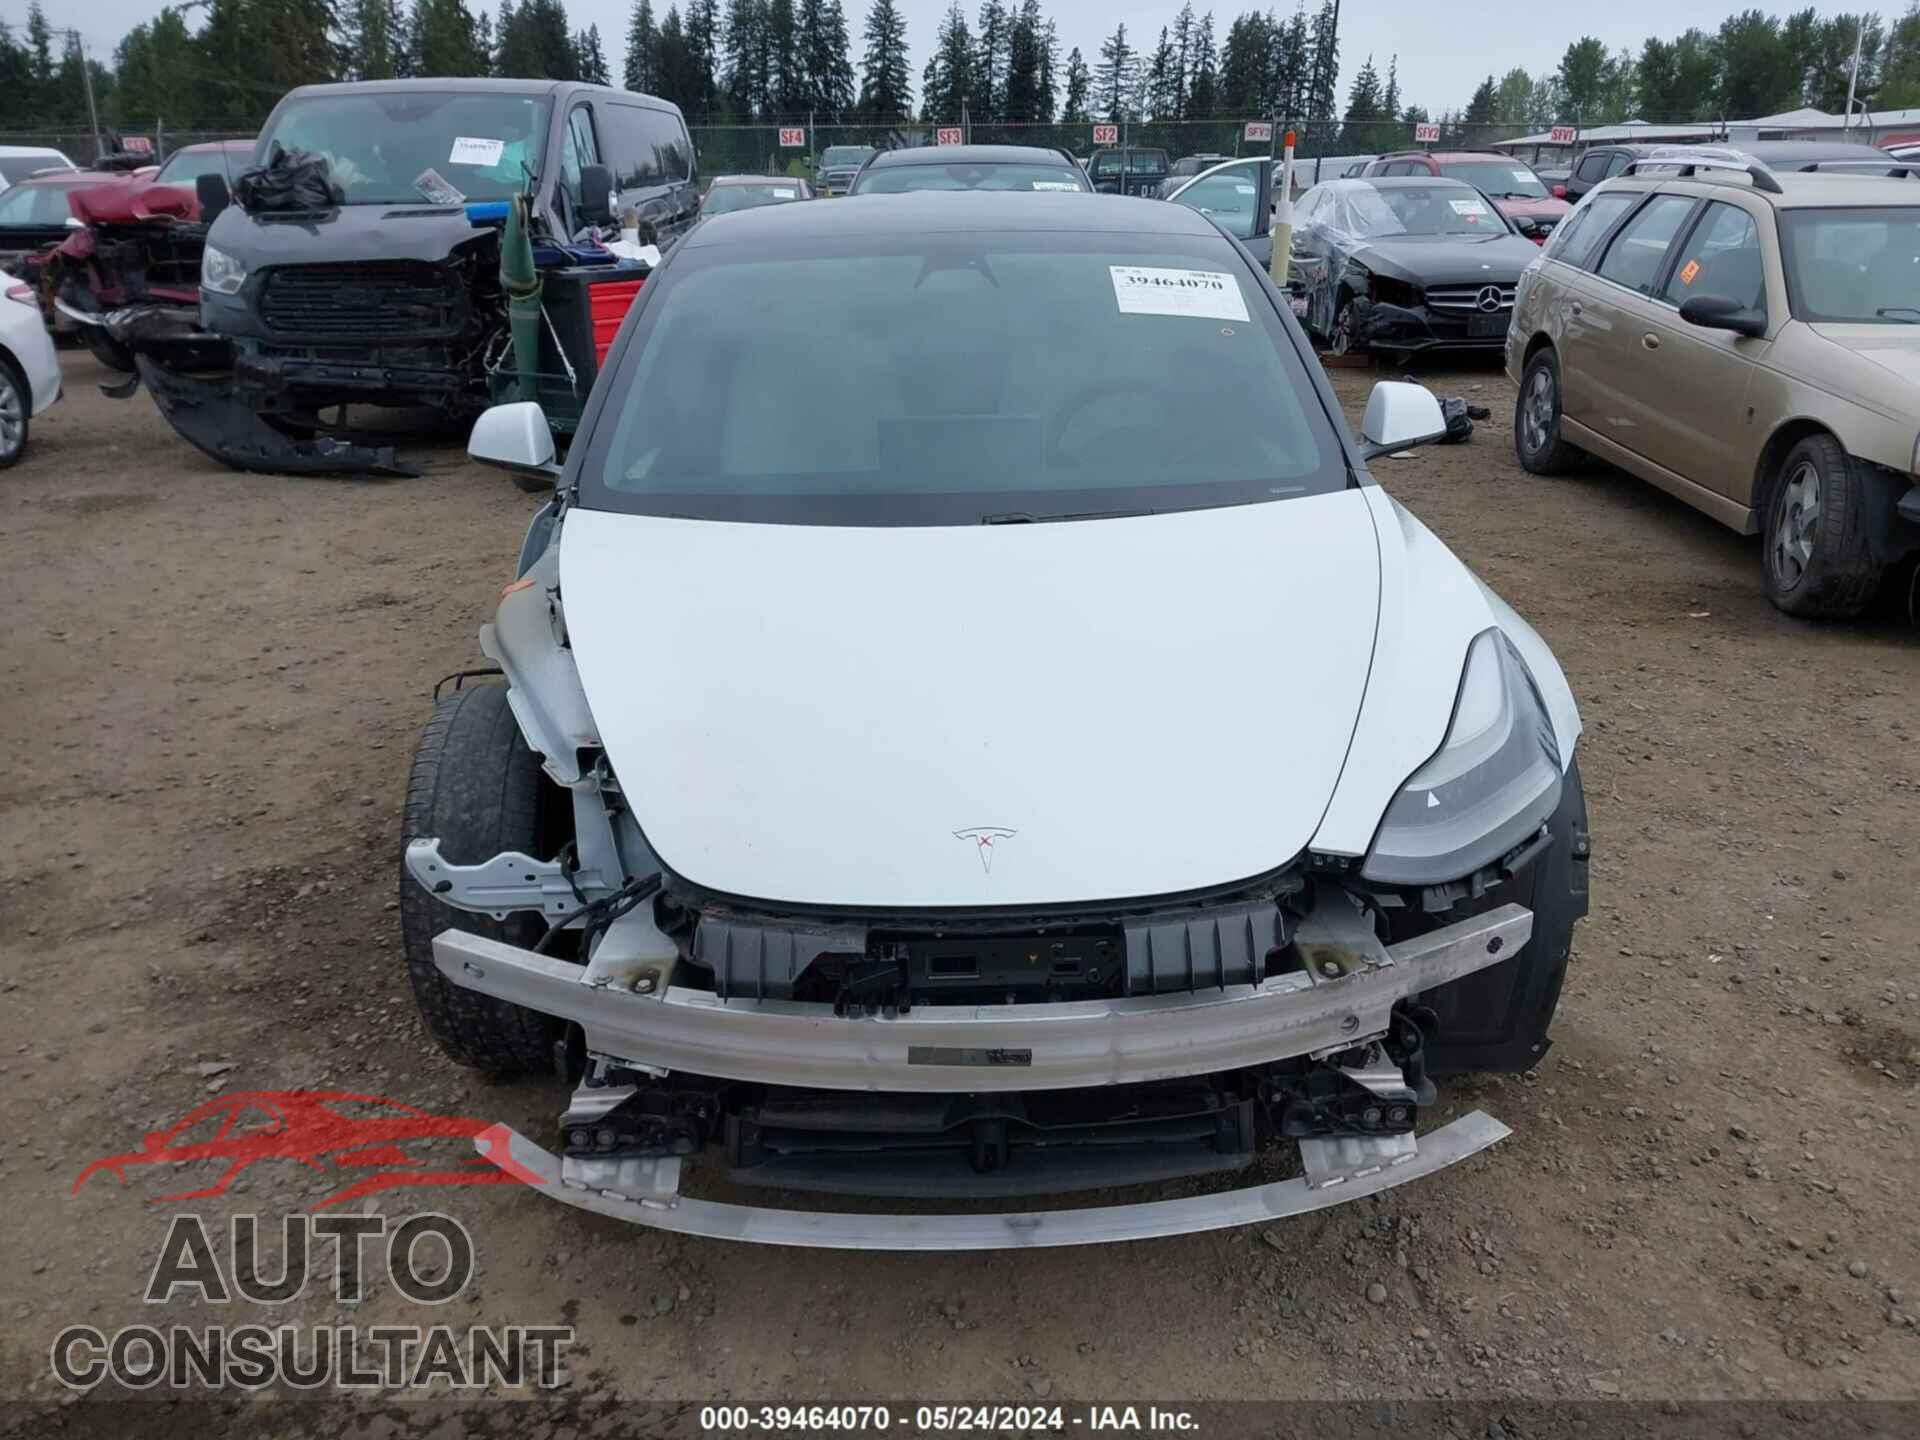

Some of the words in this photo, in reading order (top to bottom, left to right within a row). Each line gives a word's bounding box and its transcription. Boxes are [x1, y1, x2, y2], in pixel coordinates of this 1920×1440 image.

[781, 130, 802, 144] SF4
[938, 131, 961, 145] SF3
[1095, 127, 1116, 142] SF2
[1416, 127, 1439, 139] SFV2
[1551, 129, 1574, 141] SFV1
[1125, 275, 1223, 290] 39464070
